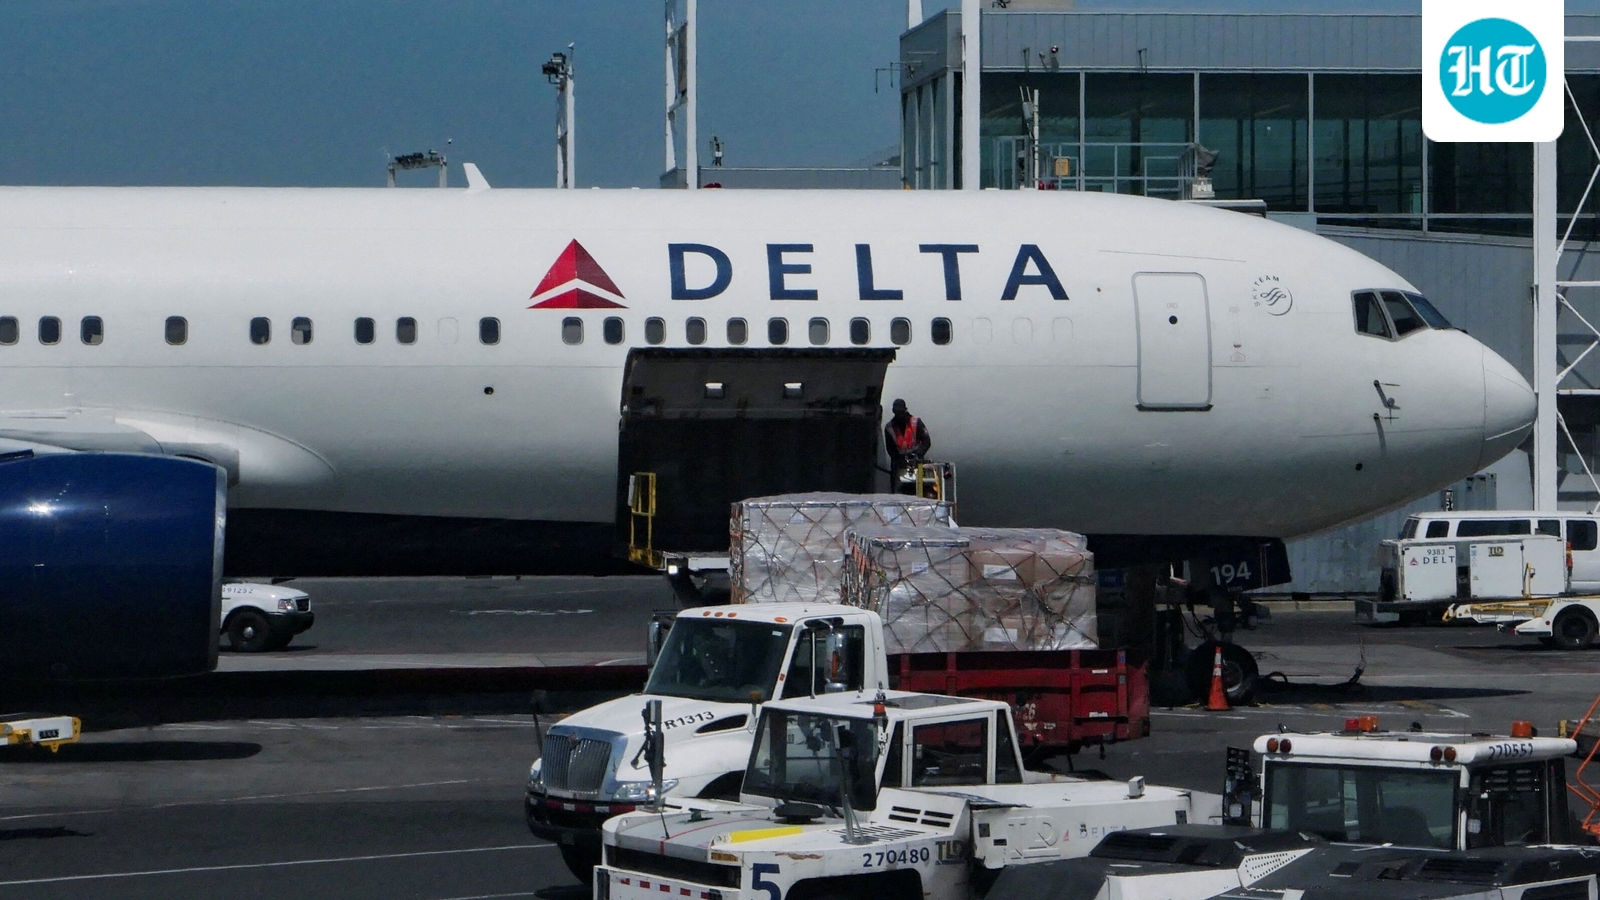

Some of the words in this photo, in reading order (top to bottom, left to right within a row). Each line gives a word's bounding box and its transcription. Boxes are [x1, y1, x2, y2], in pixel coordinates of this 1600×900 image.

[667, 243, 1070, 301] DELTA
[1252, 275, 1279, 307] SKYTEAM
[1210, 561, 1251, 585] 194
[661, 711, 715, 730] R1313
[862, 847, 930, 868] 270480
[752, 863, 782, 900] 5
